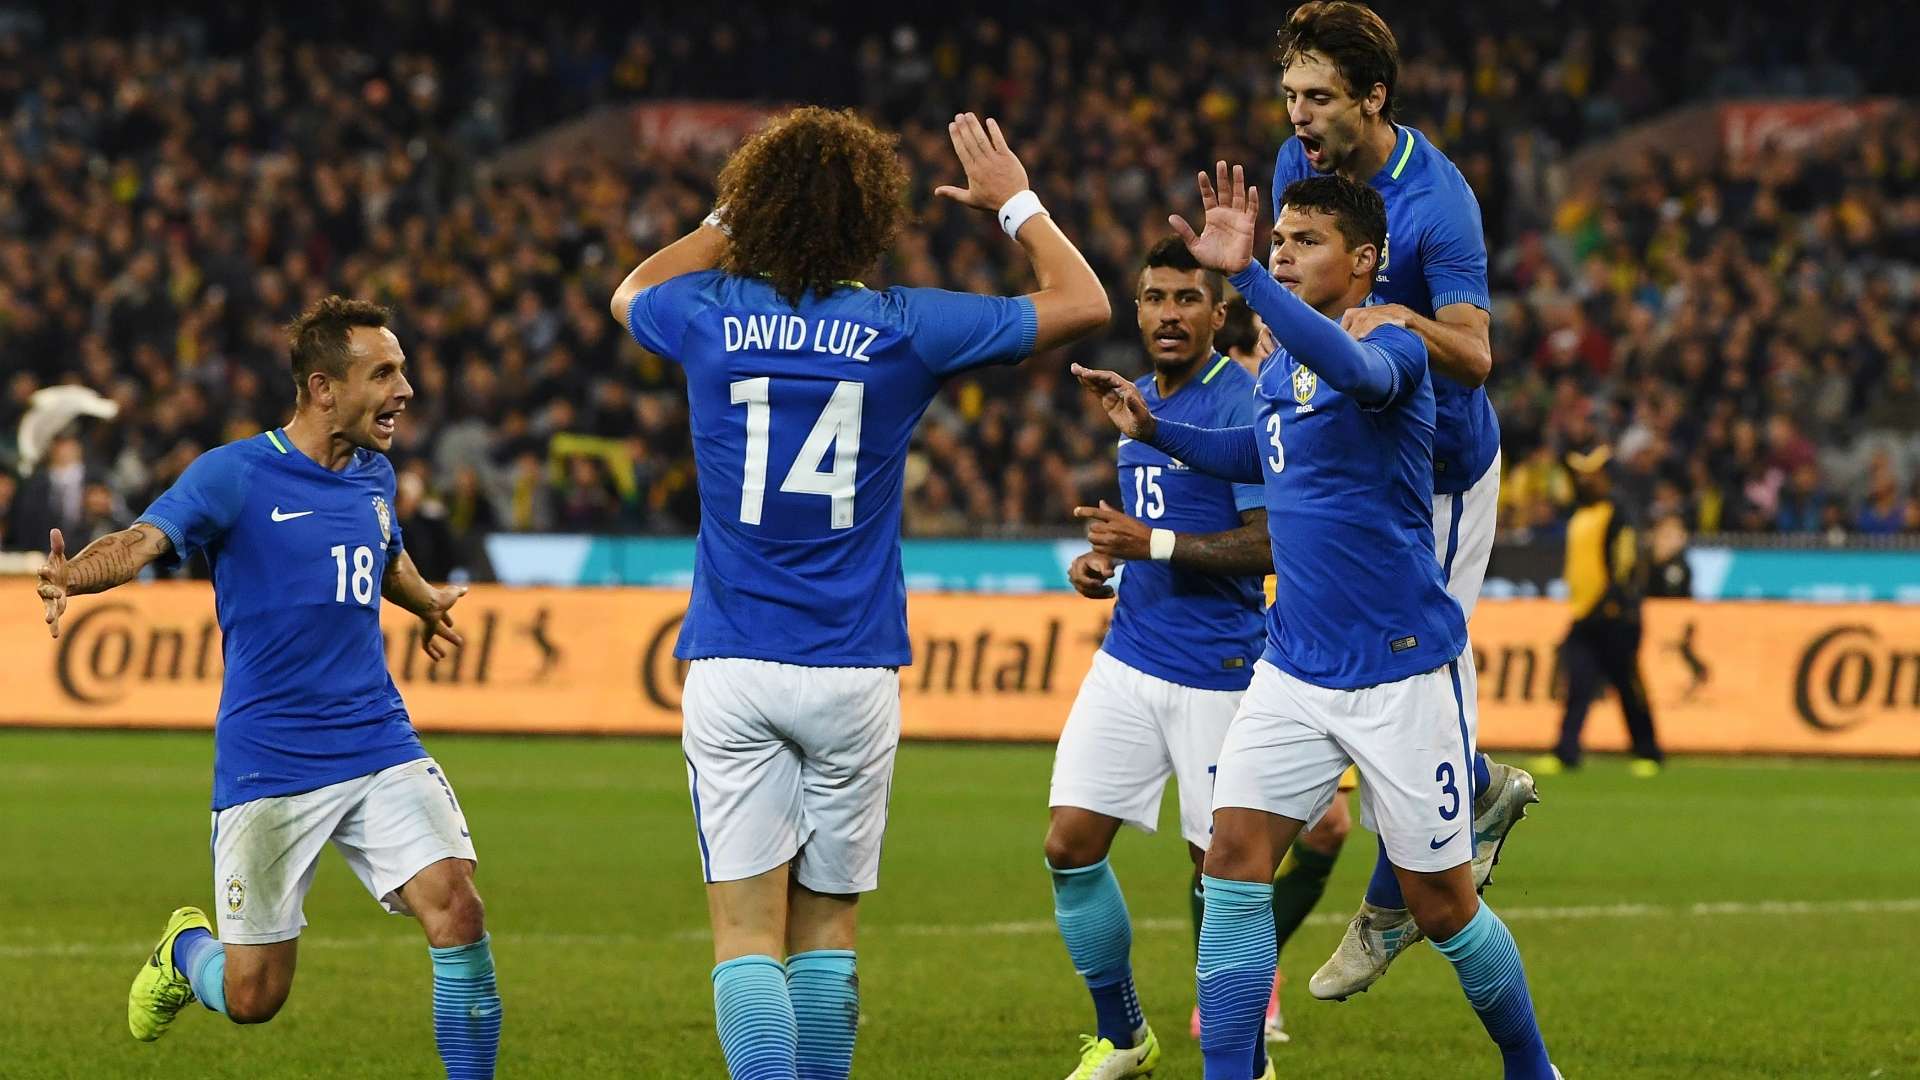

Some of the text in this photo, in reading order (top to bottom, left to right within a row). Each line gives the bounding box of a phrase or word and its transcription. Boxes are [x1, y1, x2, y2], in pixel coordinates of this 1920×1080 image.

[723, 315, 880, 362] DAVID LUIZ
[730, 376, 865, 530] 14
[1266, 413, 1285, 474] 3
[1134, 466, 1165, 520] 15
[331, 544, 374, 605] 18
[1436, 761, 1460, 821] 3
